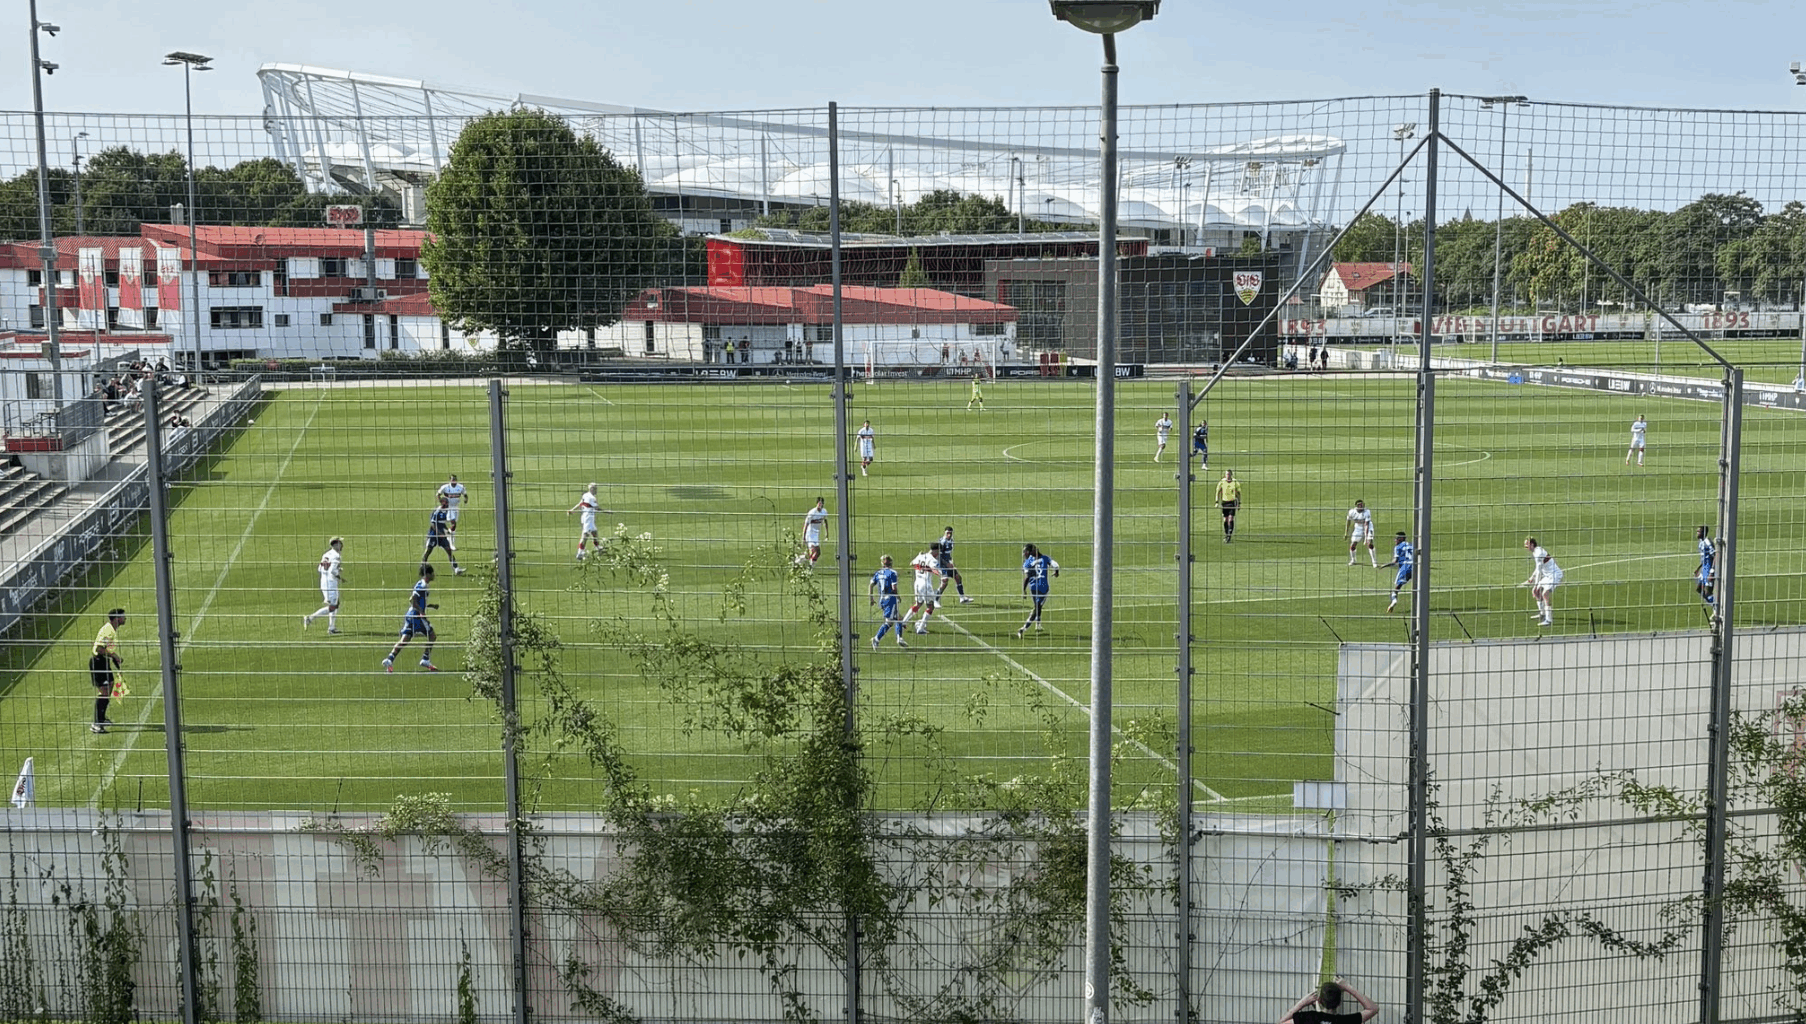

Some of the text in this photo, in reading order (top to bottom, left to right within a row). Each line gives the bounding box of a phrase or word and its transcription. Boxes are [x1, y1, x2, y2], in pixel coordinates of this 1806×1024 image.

[1431, 314, 1600, 334] VfB SUTTGART
[1702, 312, 1750, 329] 1893
[1094, 367, 1130, 376] LBW
